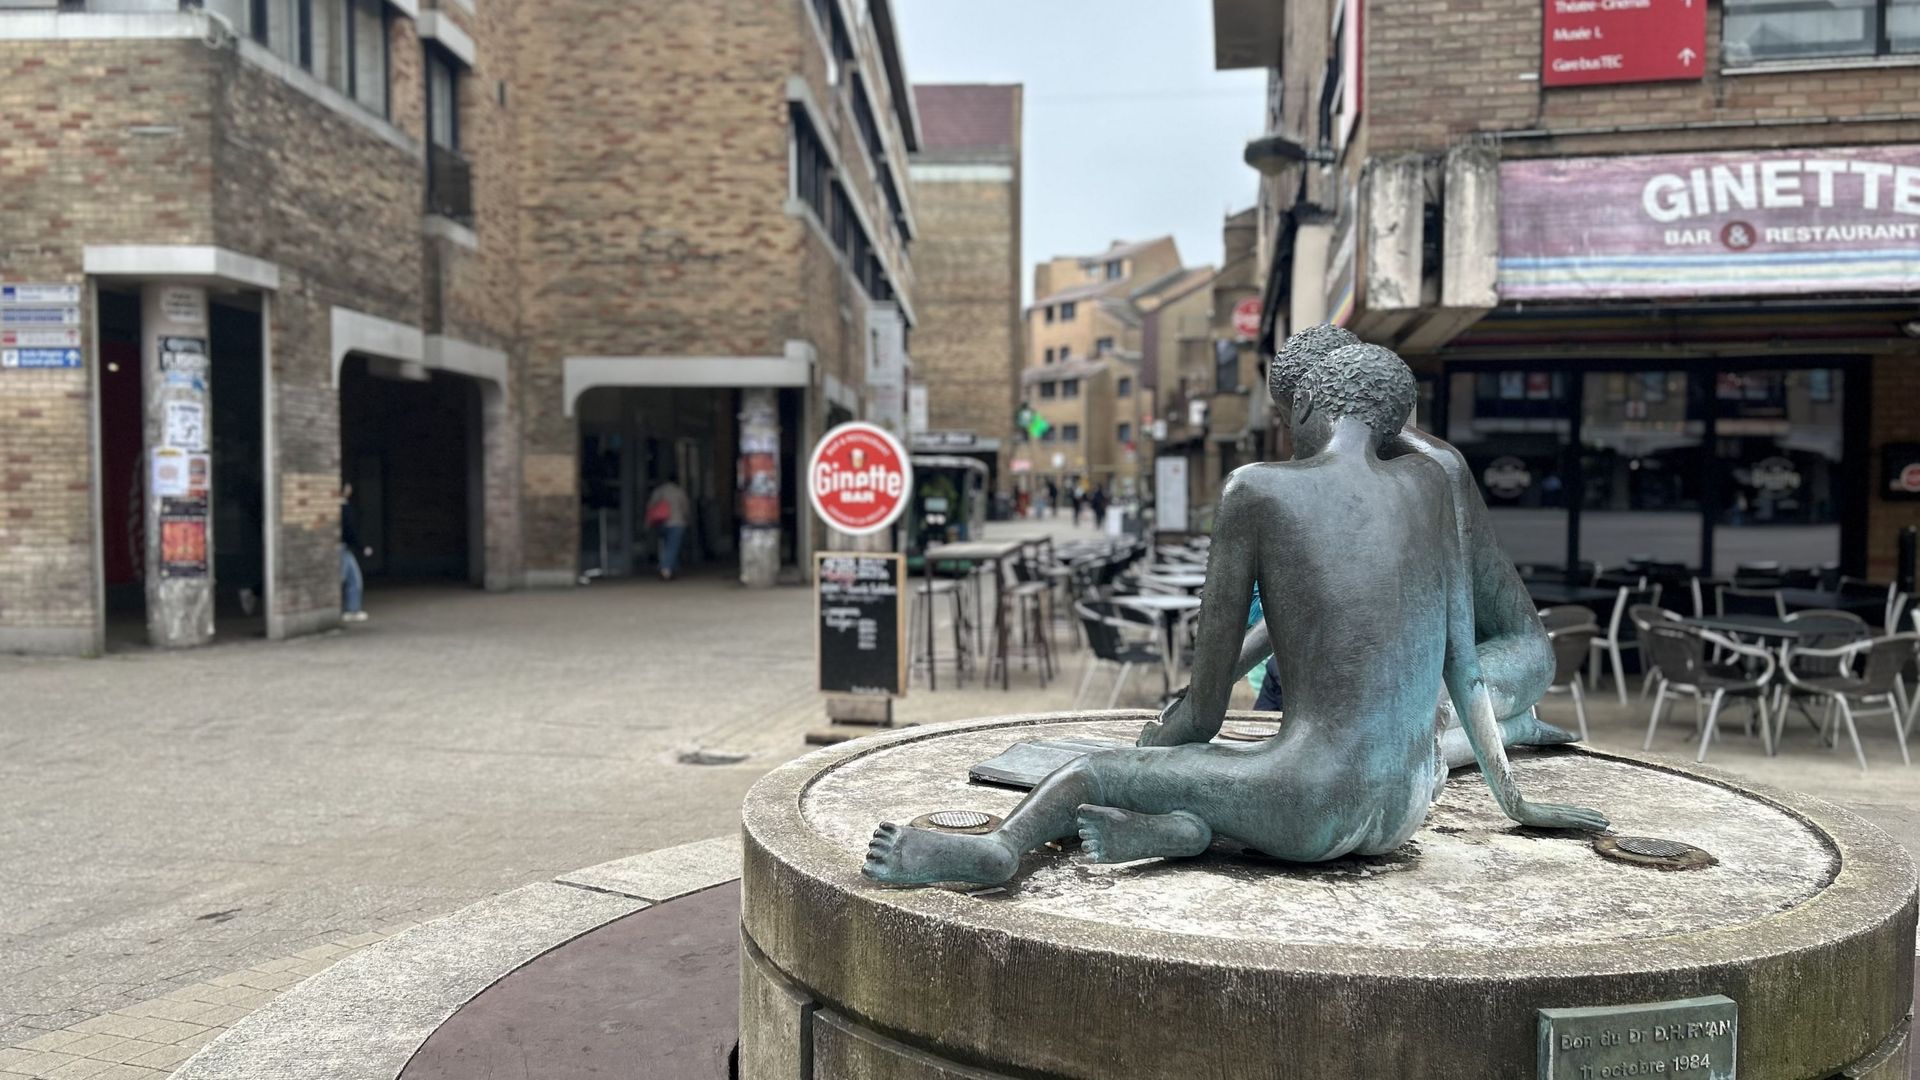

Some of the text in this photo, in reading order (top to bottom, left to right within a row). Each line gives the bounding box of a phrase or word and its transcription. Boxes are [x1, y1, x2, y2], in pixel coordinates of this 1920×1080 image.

[1642, 159, 1920, 223] GINETTE
[1664, 223, 1920, 246] BAR & RESTAURANT
[816, 461, 901, 499] Ginette
[840, 491, 876, 503] BAR
[1561, 1034, 1592, 1050] Don
[1600, 1030, 1621, 1046] du
[1628, 1028, 1648, 1043] Dr
[1580, 1053, 1710, 1080] 11 octobre 1984
